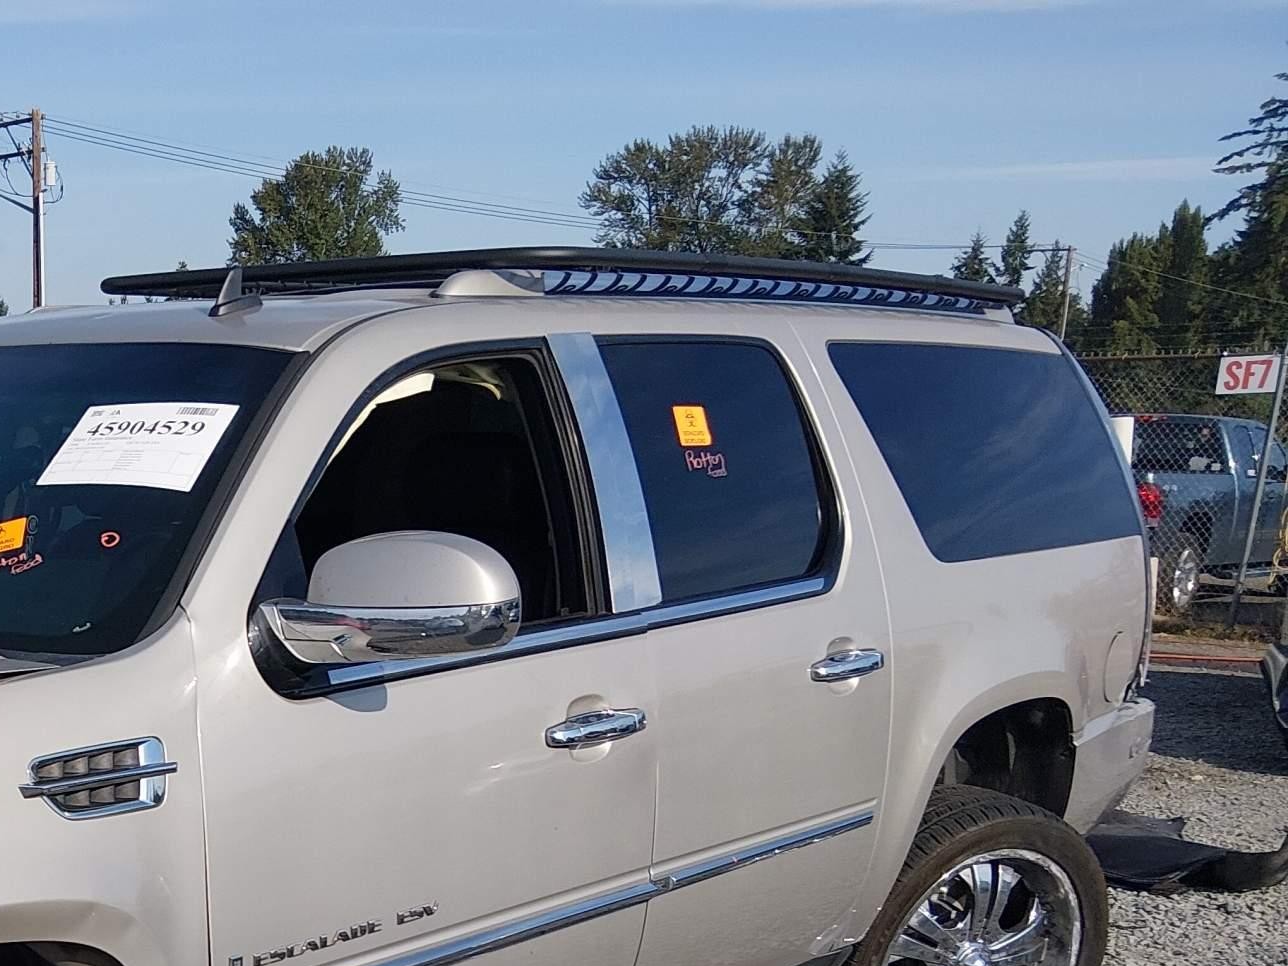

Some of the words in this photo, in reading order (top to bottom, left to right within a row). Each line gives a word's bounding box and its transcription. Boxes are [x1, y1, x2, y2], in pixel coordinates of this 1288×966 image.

[1223, 359, 1274, 391] SF7
[87, 420, 206, 437] 45904529
[396, 900, 440, 925] ESV
